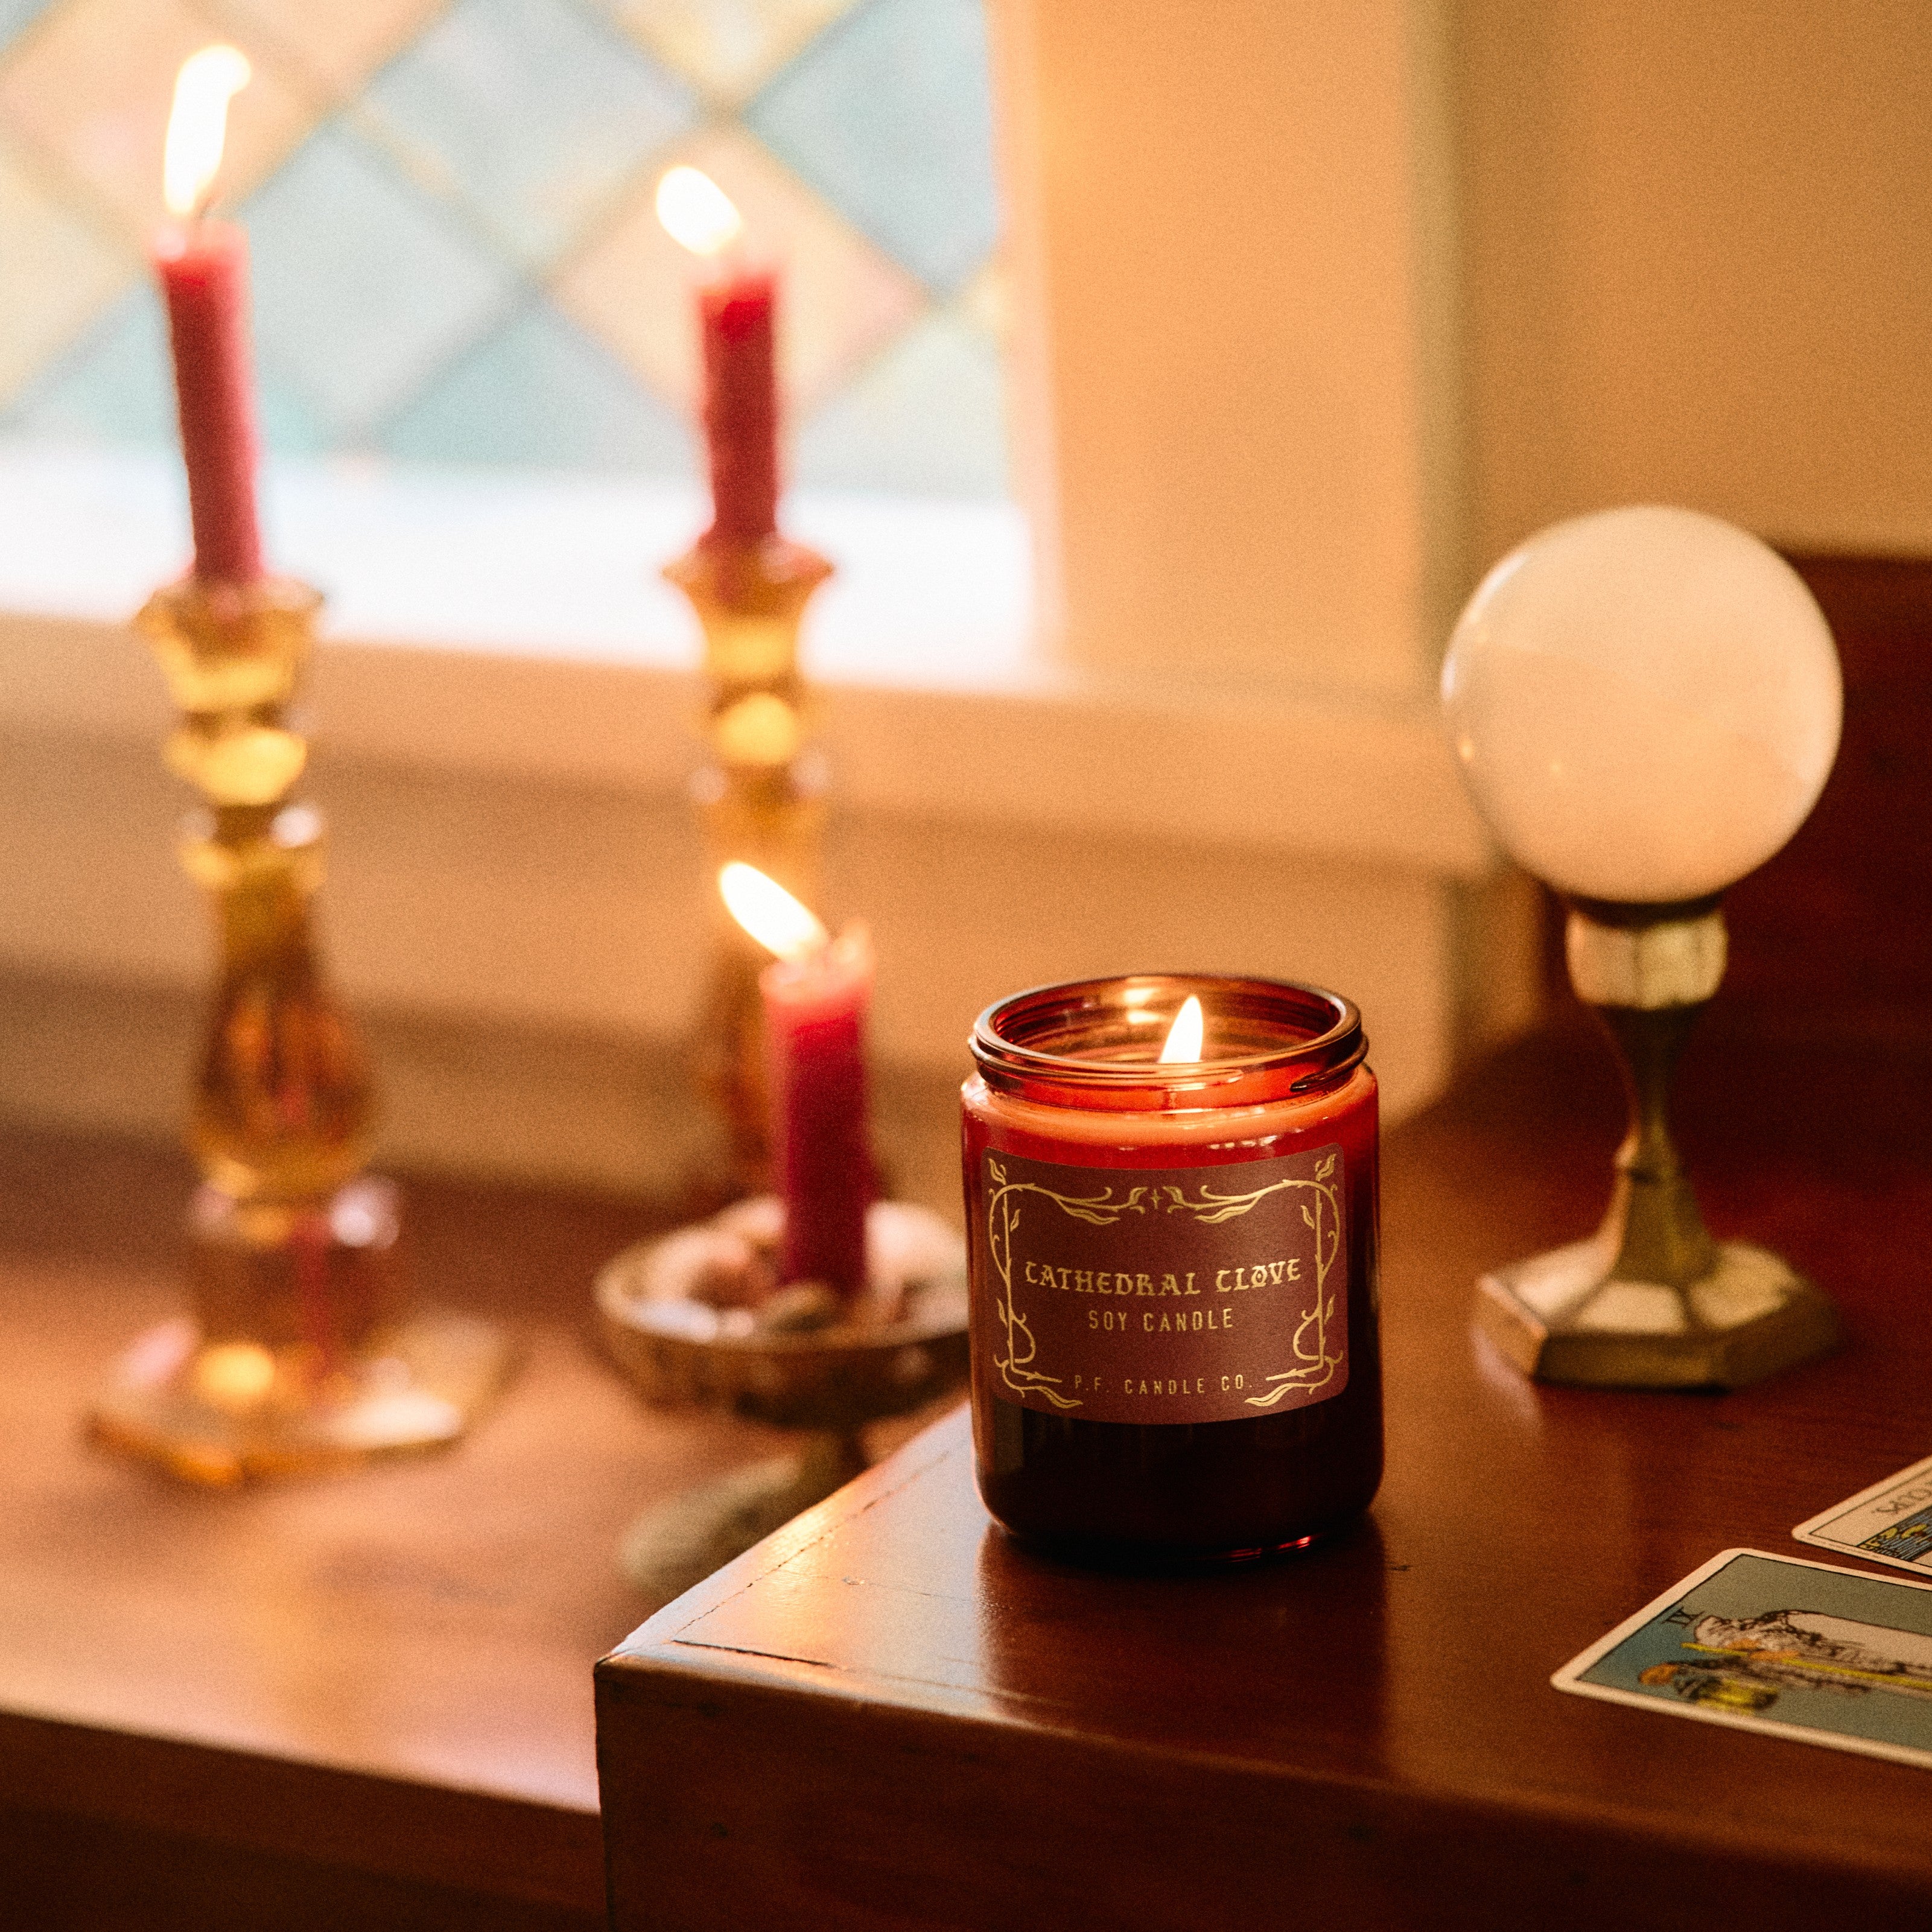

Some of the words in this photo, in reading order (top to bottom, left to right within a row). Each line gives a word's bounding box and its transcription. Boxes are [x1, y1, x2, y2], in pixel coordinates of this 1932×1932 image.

[1025, 1261, 1201, 1296] CATHEDRAL
[1215, 1258, 1301, 1292] CLOVE
[1088, 1310, 1127, 1331] SOY
[1143, 1308, 1233, 1332] CANDLE
[1075, 1374, 1109, 1393] P.F.
[1125, 1378, 1206, 1395] CANDLE
[1221, 1374, 1253, 1391] CO.
